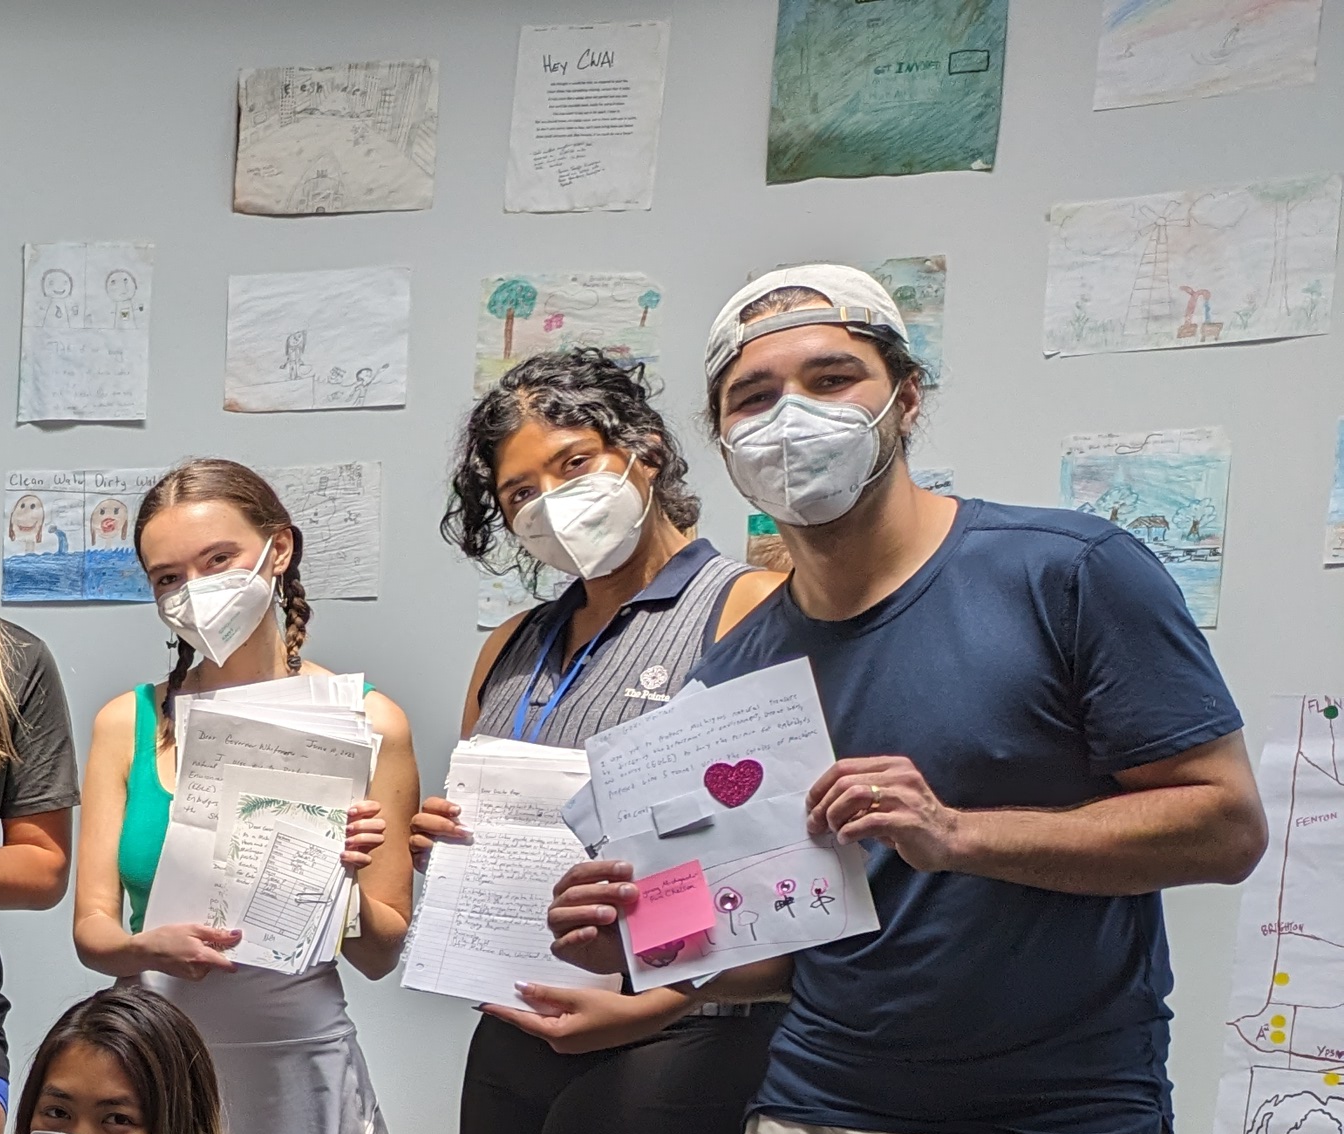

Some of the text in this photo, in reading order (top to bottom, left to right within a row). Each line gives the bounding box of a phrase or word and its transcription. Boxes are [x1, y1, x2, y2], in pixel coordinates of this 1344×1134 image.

[576, 48, 614, 69] CWA!
[9, 473, 43, 486] Clean
[94, 473, 157, 491] Dirty Wat
[623, 687, 671, 702] The Pointe
[198, 729, 215, 739] Dear
[224, 733, 256, 747] Governor
[306, 738, 326, 751] June
[1295, 812, 1339, 828] FENTON
[1260, 921, 1304, 936] BRIGHTON
